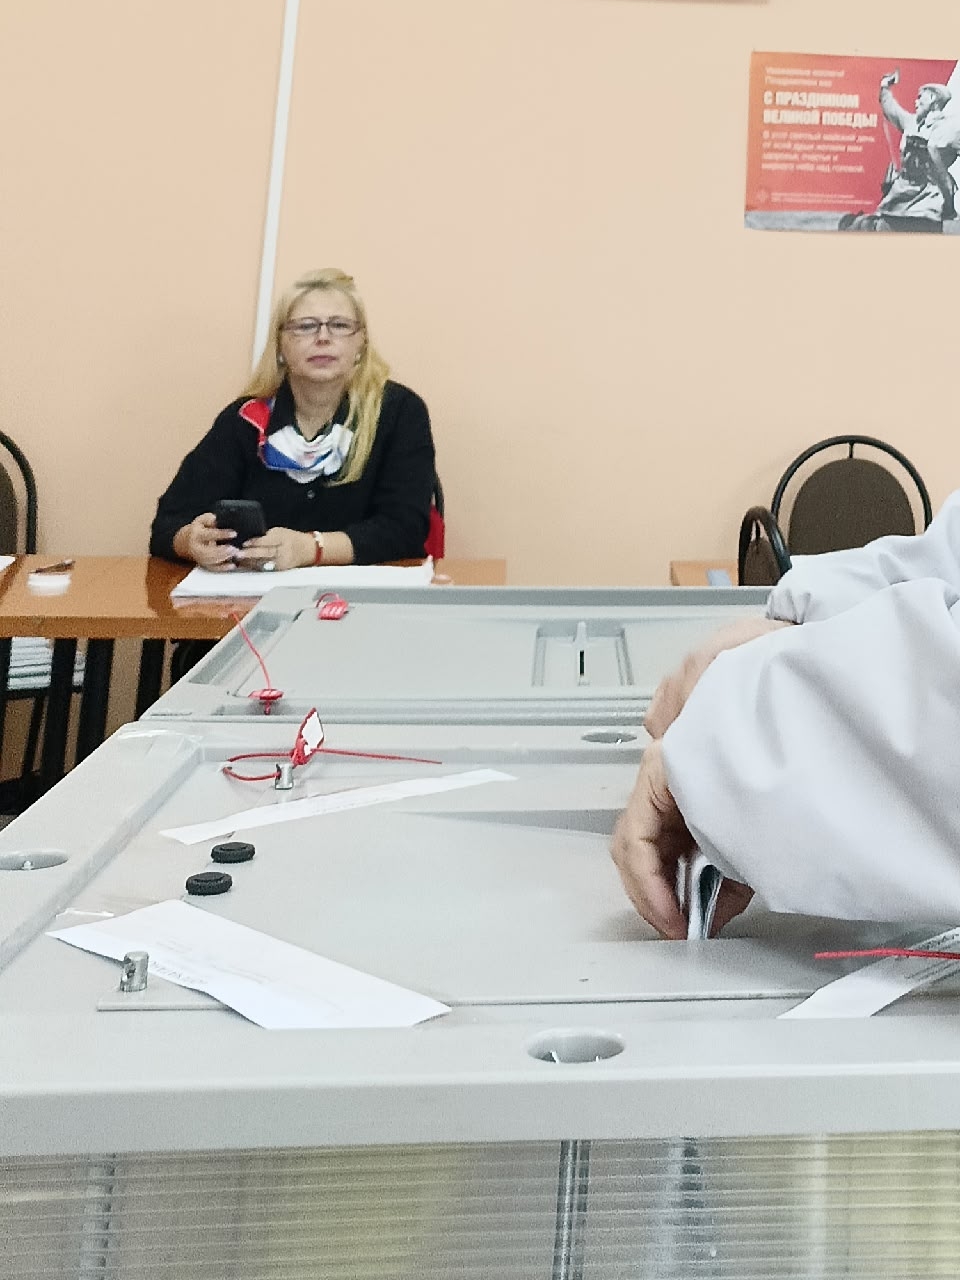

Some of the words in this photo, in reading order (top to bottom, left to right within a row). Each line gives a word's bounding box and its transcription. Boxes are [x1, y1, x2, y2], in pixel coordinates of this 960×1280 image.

[764, 91, 772, 105] С
[775, 91, 859, 109] ПРАЗДНИКОМ
[763, 109, 820, 124] ВЕЛИКОЙ
[822, 111, 878, 128] ПОБЕДЫ!
